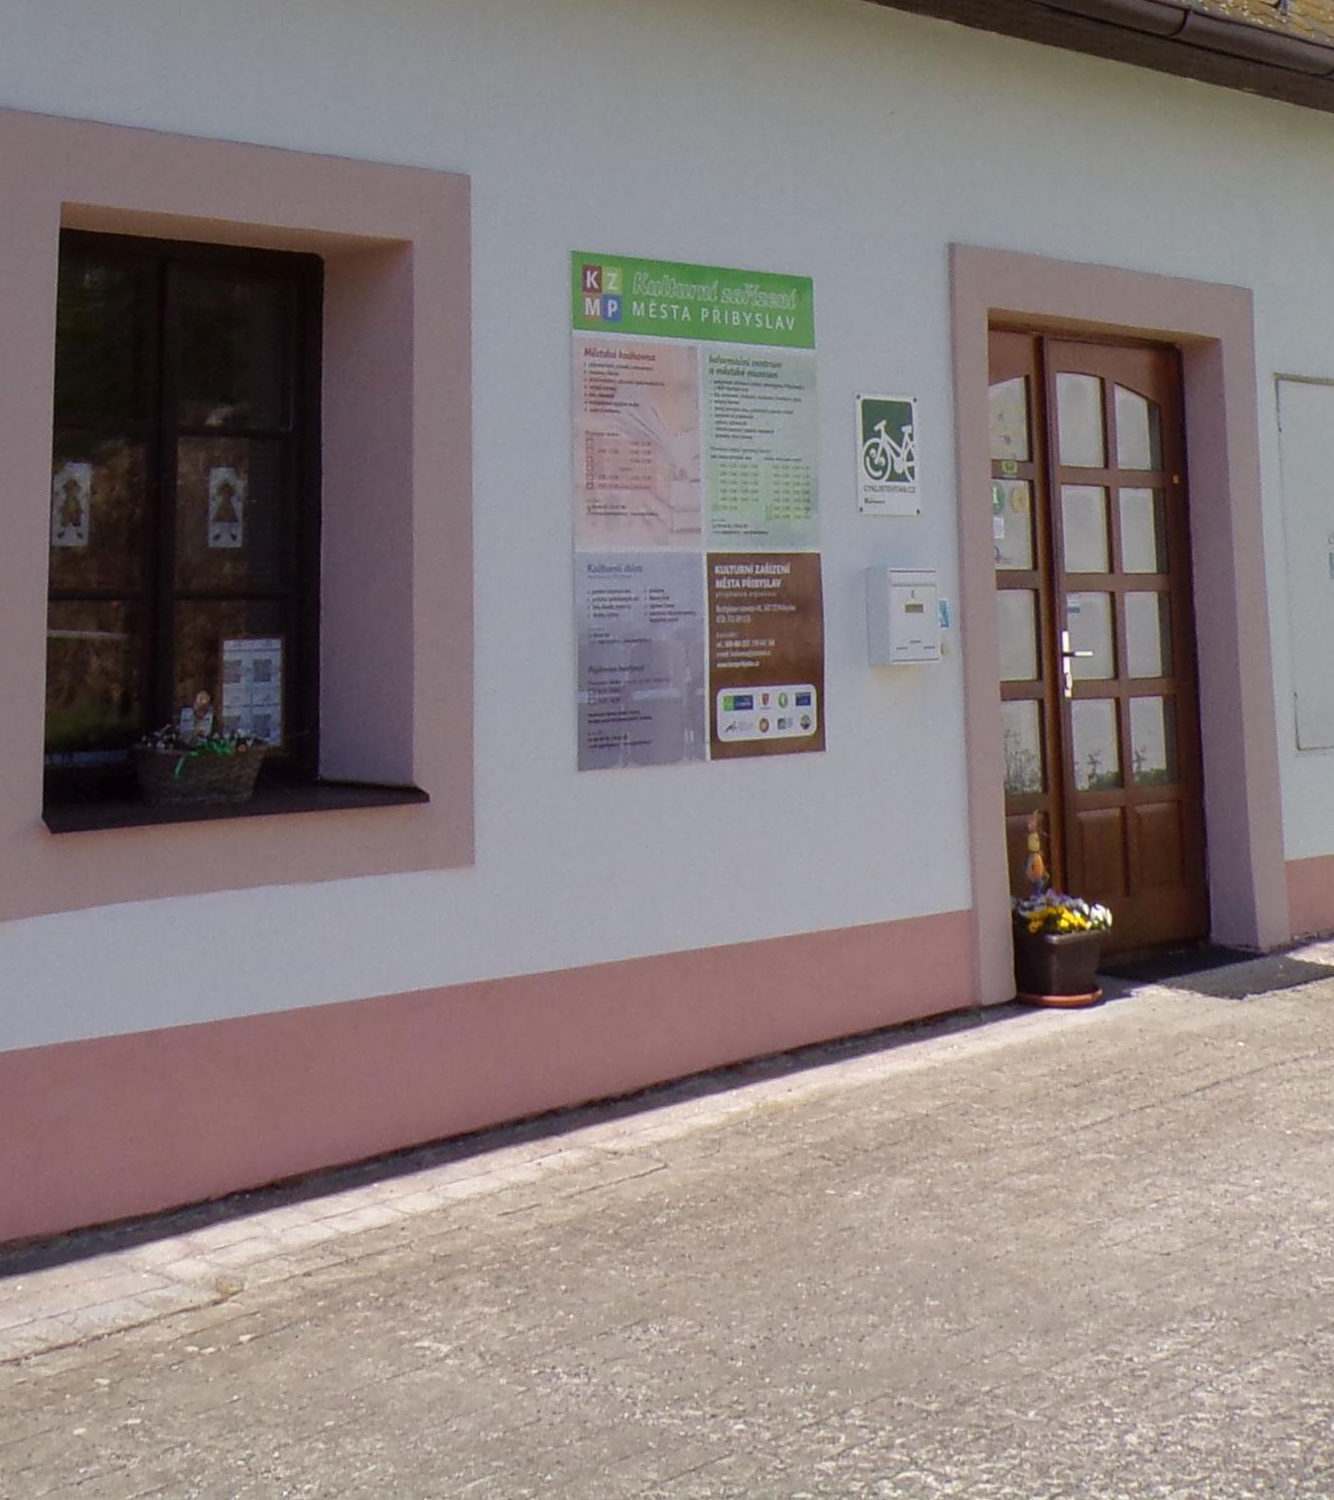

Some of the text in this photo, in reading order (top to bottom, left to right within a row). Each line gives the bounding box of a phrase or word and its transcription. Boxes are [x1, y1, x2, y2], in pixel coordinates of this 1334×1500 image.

[633, 271, 797, 310] Kulturní zařízení
[632, 300, 796, 332] MĚSTA PŘIBYSLAV
